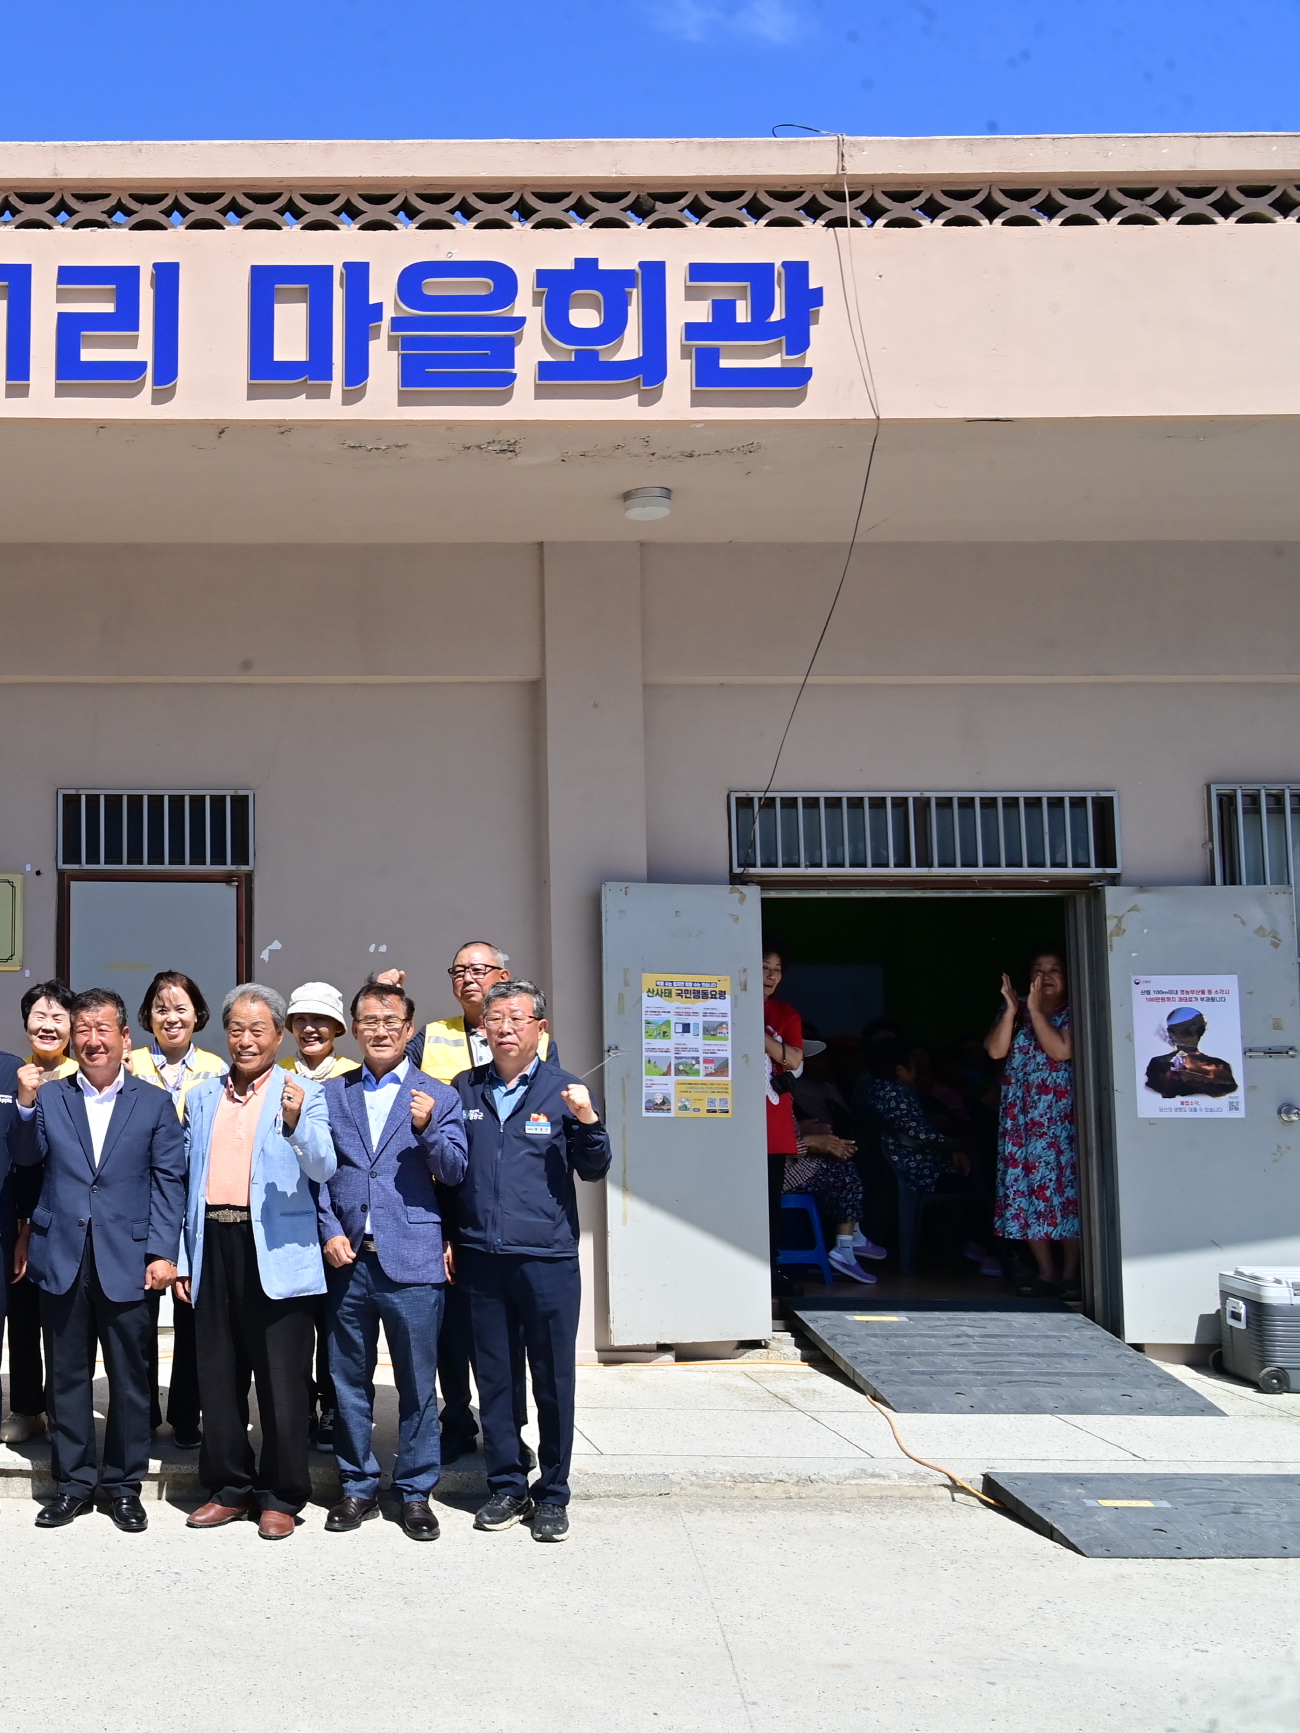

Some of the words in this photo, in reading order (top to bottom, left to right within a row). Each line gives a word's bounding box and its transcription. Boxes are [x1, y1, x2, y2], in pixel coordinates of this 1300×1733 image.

[247, 257, 824, 390] 마을회관
[646, 988, 672, 998] 산사태
[675, 989, 727, 1000] 국민행동요령
